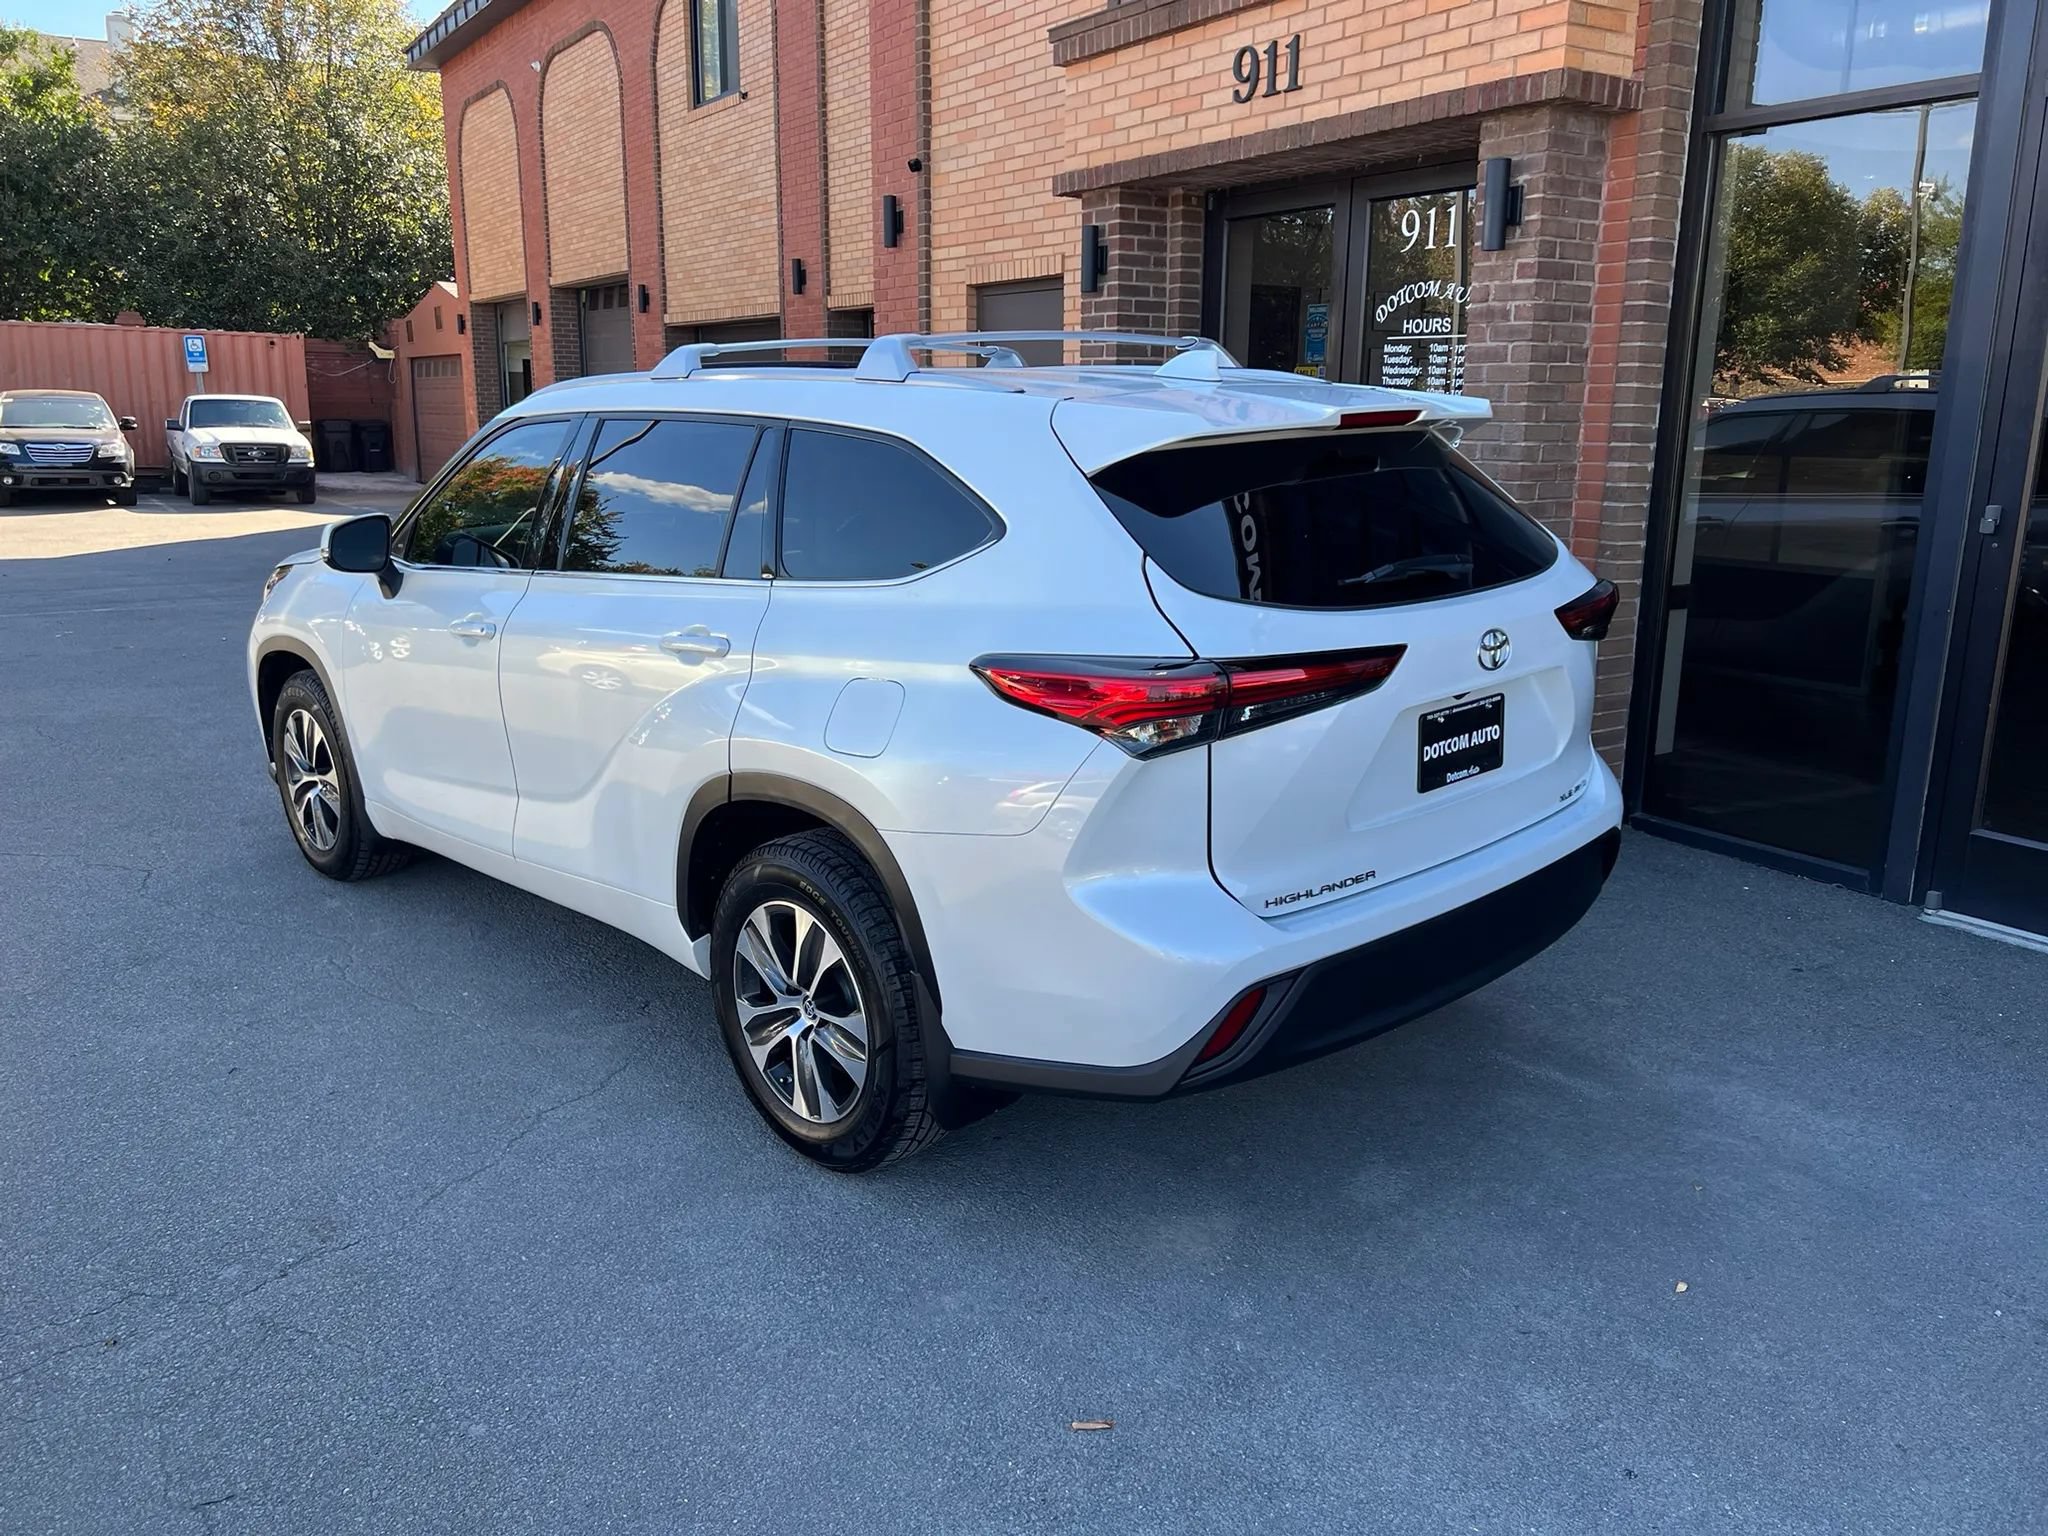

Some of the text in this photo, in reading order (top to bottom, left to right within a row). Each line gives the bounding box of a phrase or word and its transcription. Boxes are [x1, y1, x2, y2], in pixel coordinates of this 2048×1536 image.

[1233, 33, 1303, 104] 911
[1400, 204, 1457, 253] 911
[1375, 280, 1473, 324] DOTCOM AU
[1403, 317, 1452, 334] HOURS
[1383, 355, 1413, 365] Tuesday:
[1428, 354, 1448, 363] 10am
[1384, 343, 1412, 354] Monday:
[1429, 343, 1448, 352] 10am
[1382, 366, 1422, 376] Wednesday:
[1428, 366, 1447, 374] 10am
[1382, 376, 1414, 387] Thursday:
[1427, 376, 1446, 385] 10am
[1423, 724, 1500, 762] DOTCOM AUTO
[799, 881, 826, 906] EDGE
[1264, 870, 1377, 909] HIGHLANDER
